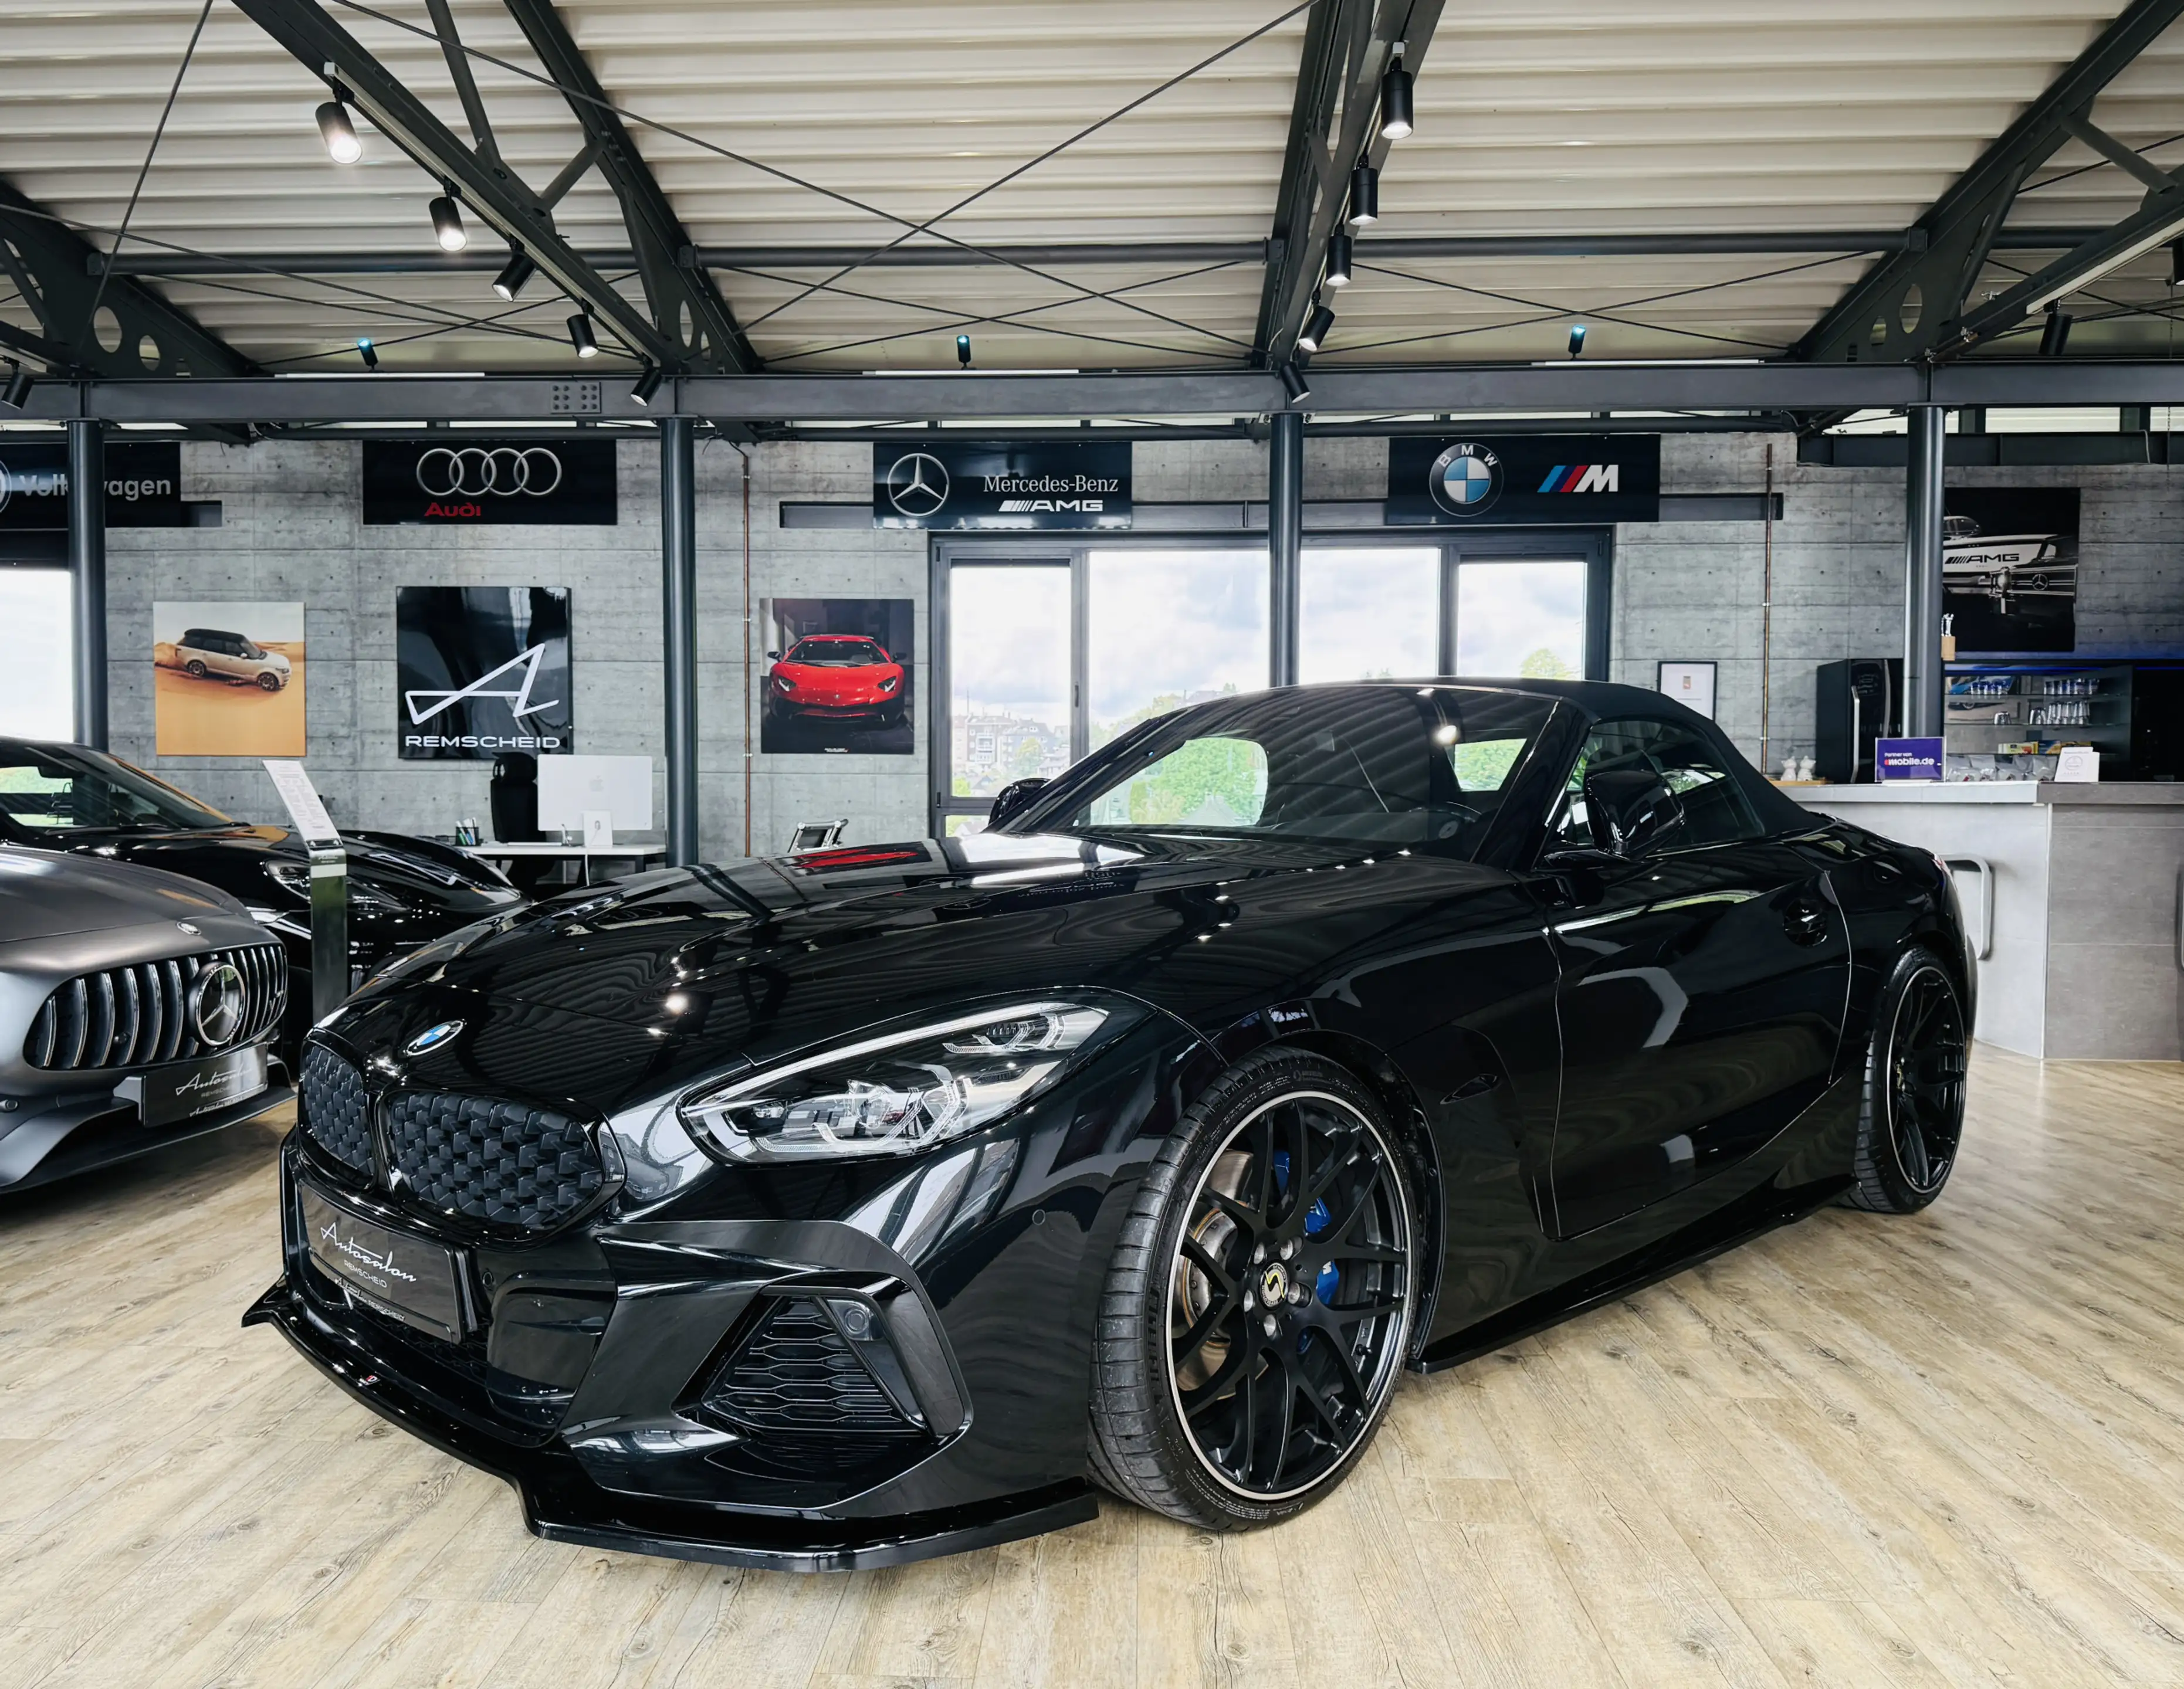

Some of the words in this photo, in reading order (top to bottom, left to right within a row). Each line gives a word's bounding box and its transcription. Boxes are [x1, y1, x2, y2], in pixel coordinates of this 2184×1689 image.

[1437, 445, 1498, 467] BMW
[983, 474, 1119, 493] Mercedes-Benz
[424, 502, 482, 517] Audi
[1030, 500, 1103, 512] AMG
[1966, 553, 2020, 564] AMG
[405, 736, 560, 748] REMSCHEID
[320, 1222, 417, 1283] Autosalon
[344, 1260, 388, 1288] REMSCHEID
